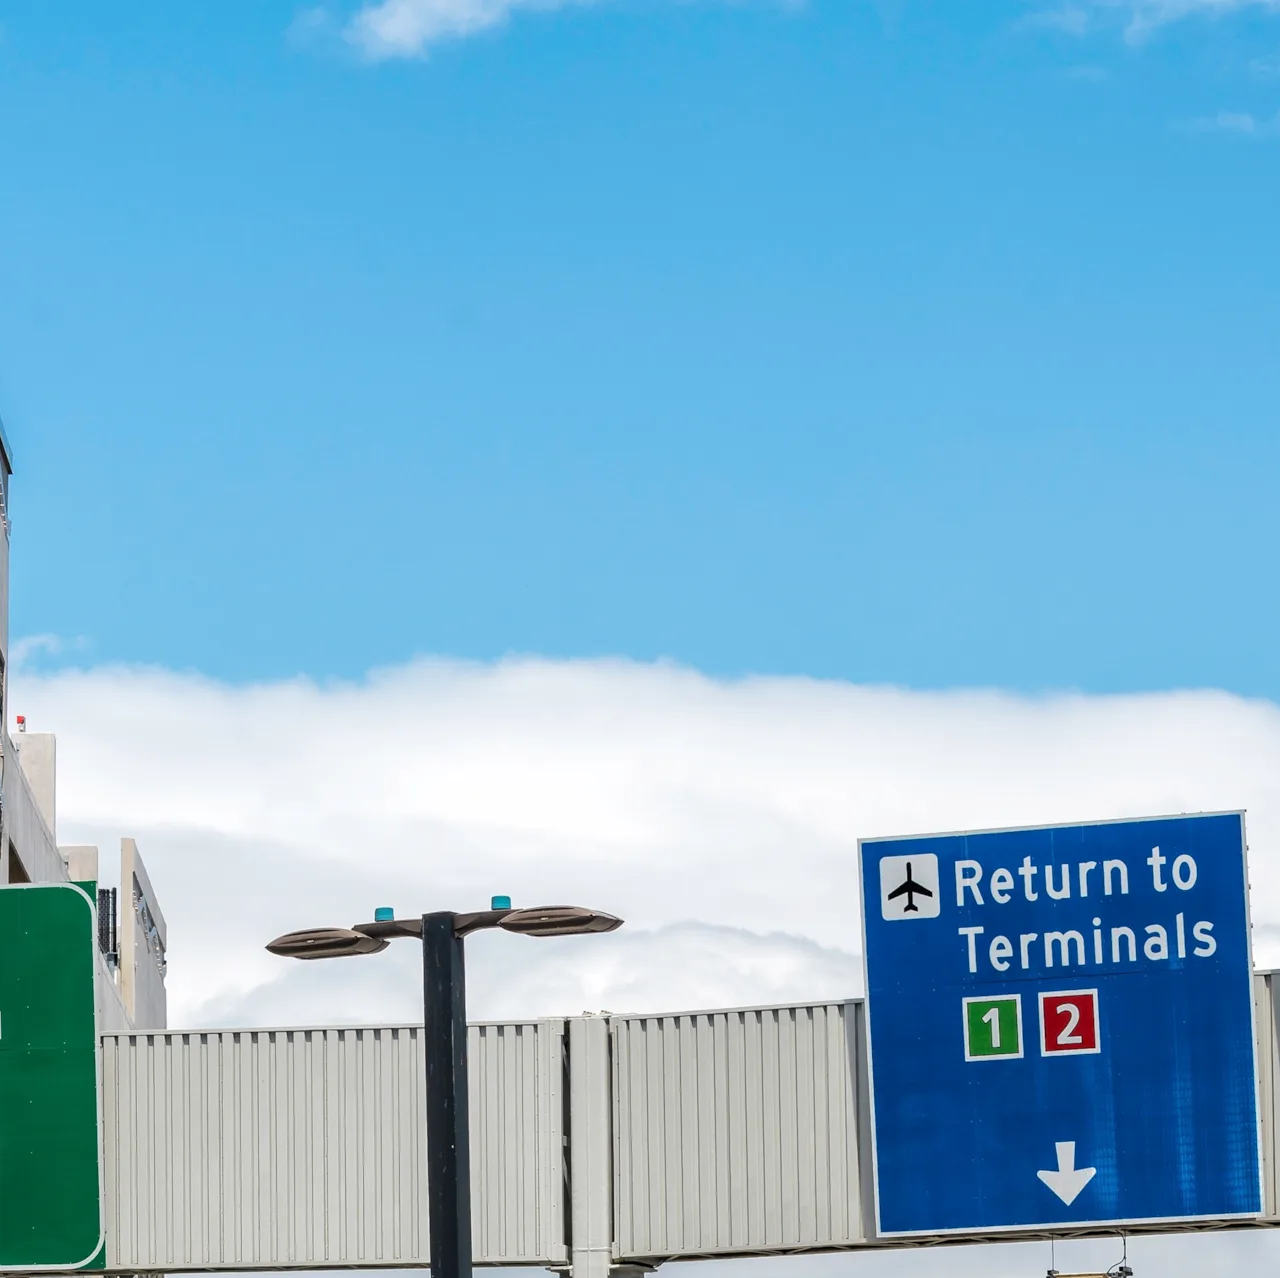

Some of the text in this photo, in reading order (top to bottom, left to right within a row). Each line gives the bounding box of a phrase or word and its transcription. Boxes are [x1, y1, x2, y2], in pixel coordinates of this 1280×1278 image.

[954, 845, 1199, 907] Return to
[958, 912, 1217, 973] Terminals
[981, 1002, 1083, 1048] 1 2
